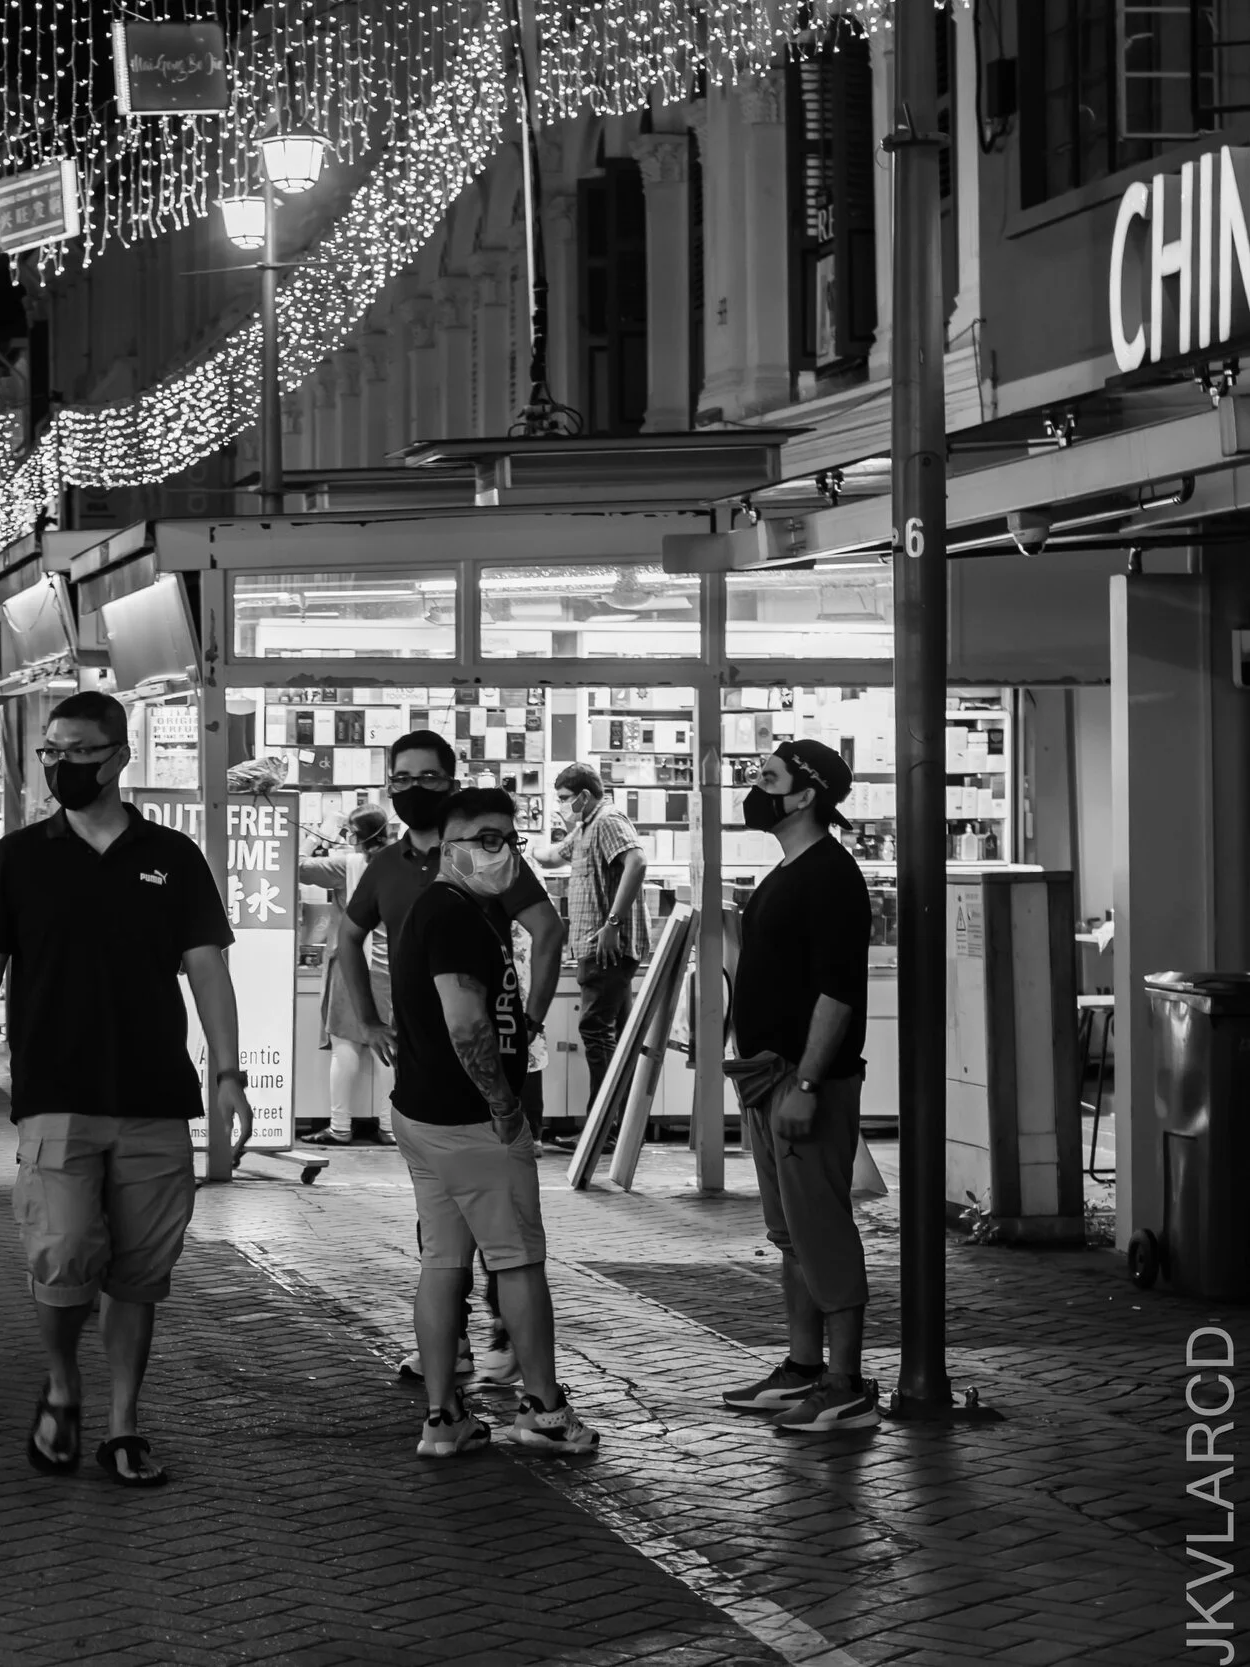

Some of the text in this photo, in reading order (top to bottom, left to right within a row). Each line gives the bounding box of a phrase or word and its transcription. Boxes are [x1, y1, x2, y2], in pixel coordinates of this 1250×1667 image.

[905, 516, 925, 558] 6
[142, 803, 290, 837] DUT FREE
[252, 1105, 283, 1119] treet
